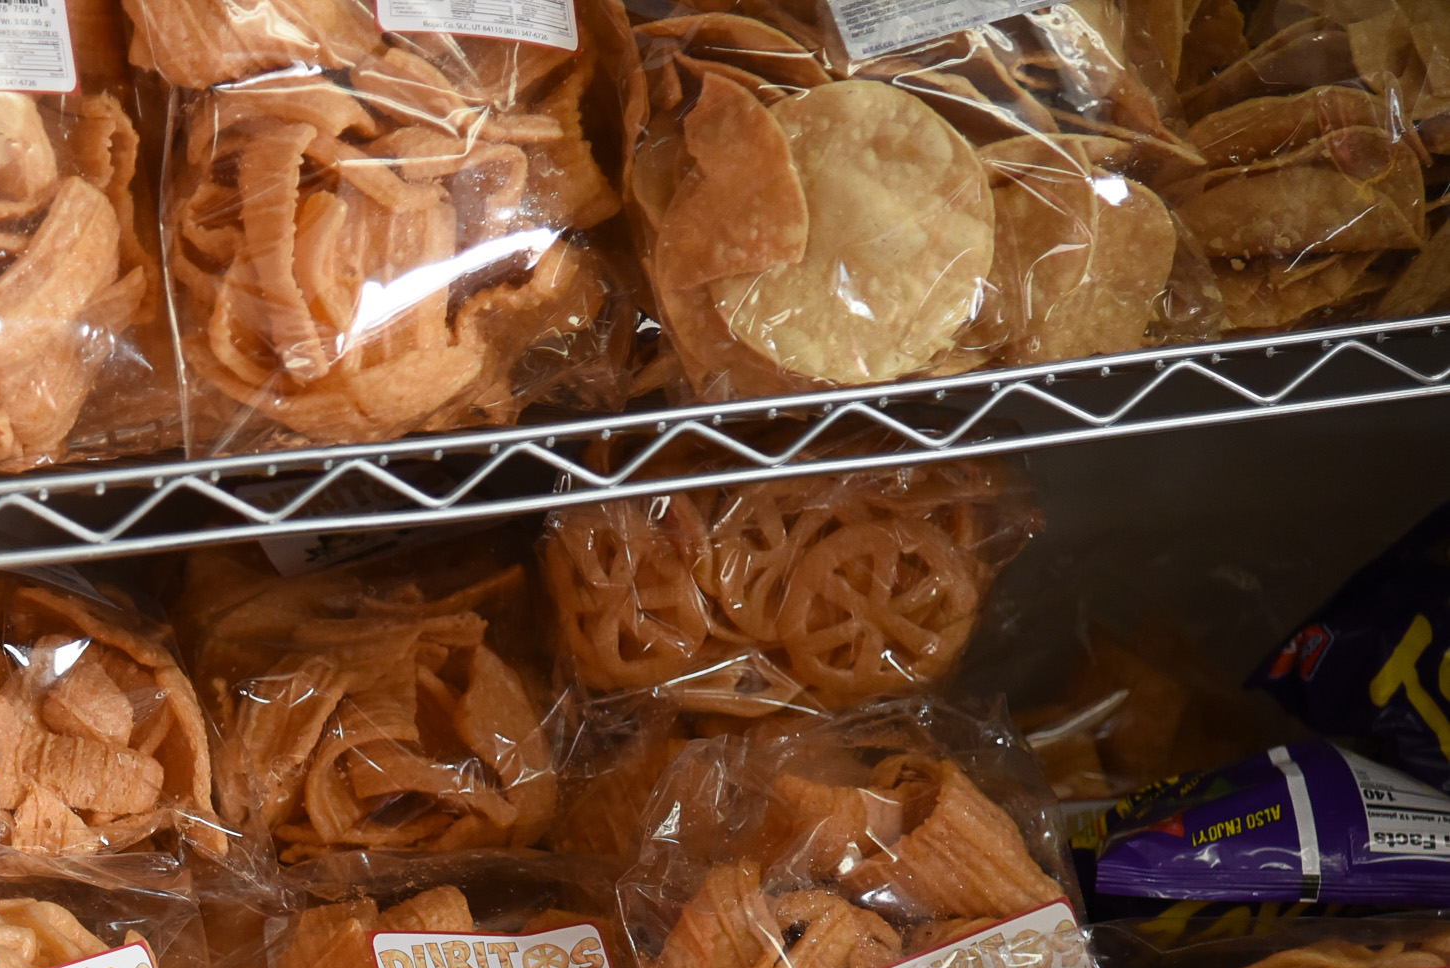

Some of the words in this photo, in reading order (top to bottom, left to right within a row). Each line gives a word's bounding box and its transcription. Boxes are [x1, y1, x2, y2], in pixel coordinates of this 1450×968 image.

[14, 5, 40, 14] 75912
[1363, 788, 1397, 802] 140
[1245, 804, 1281, 831] ALSO
[1191, 817, 1242, 848] ENJOY!
[1373, 832, 1437, 850] Facts
